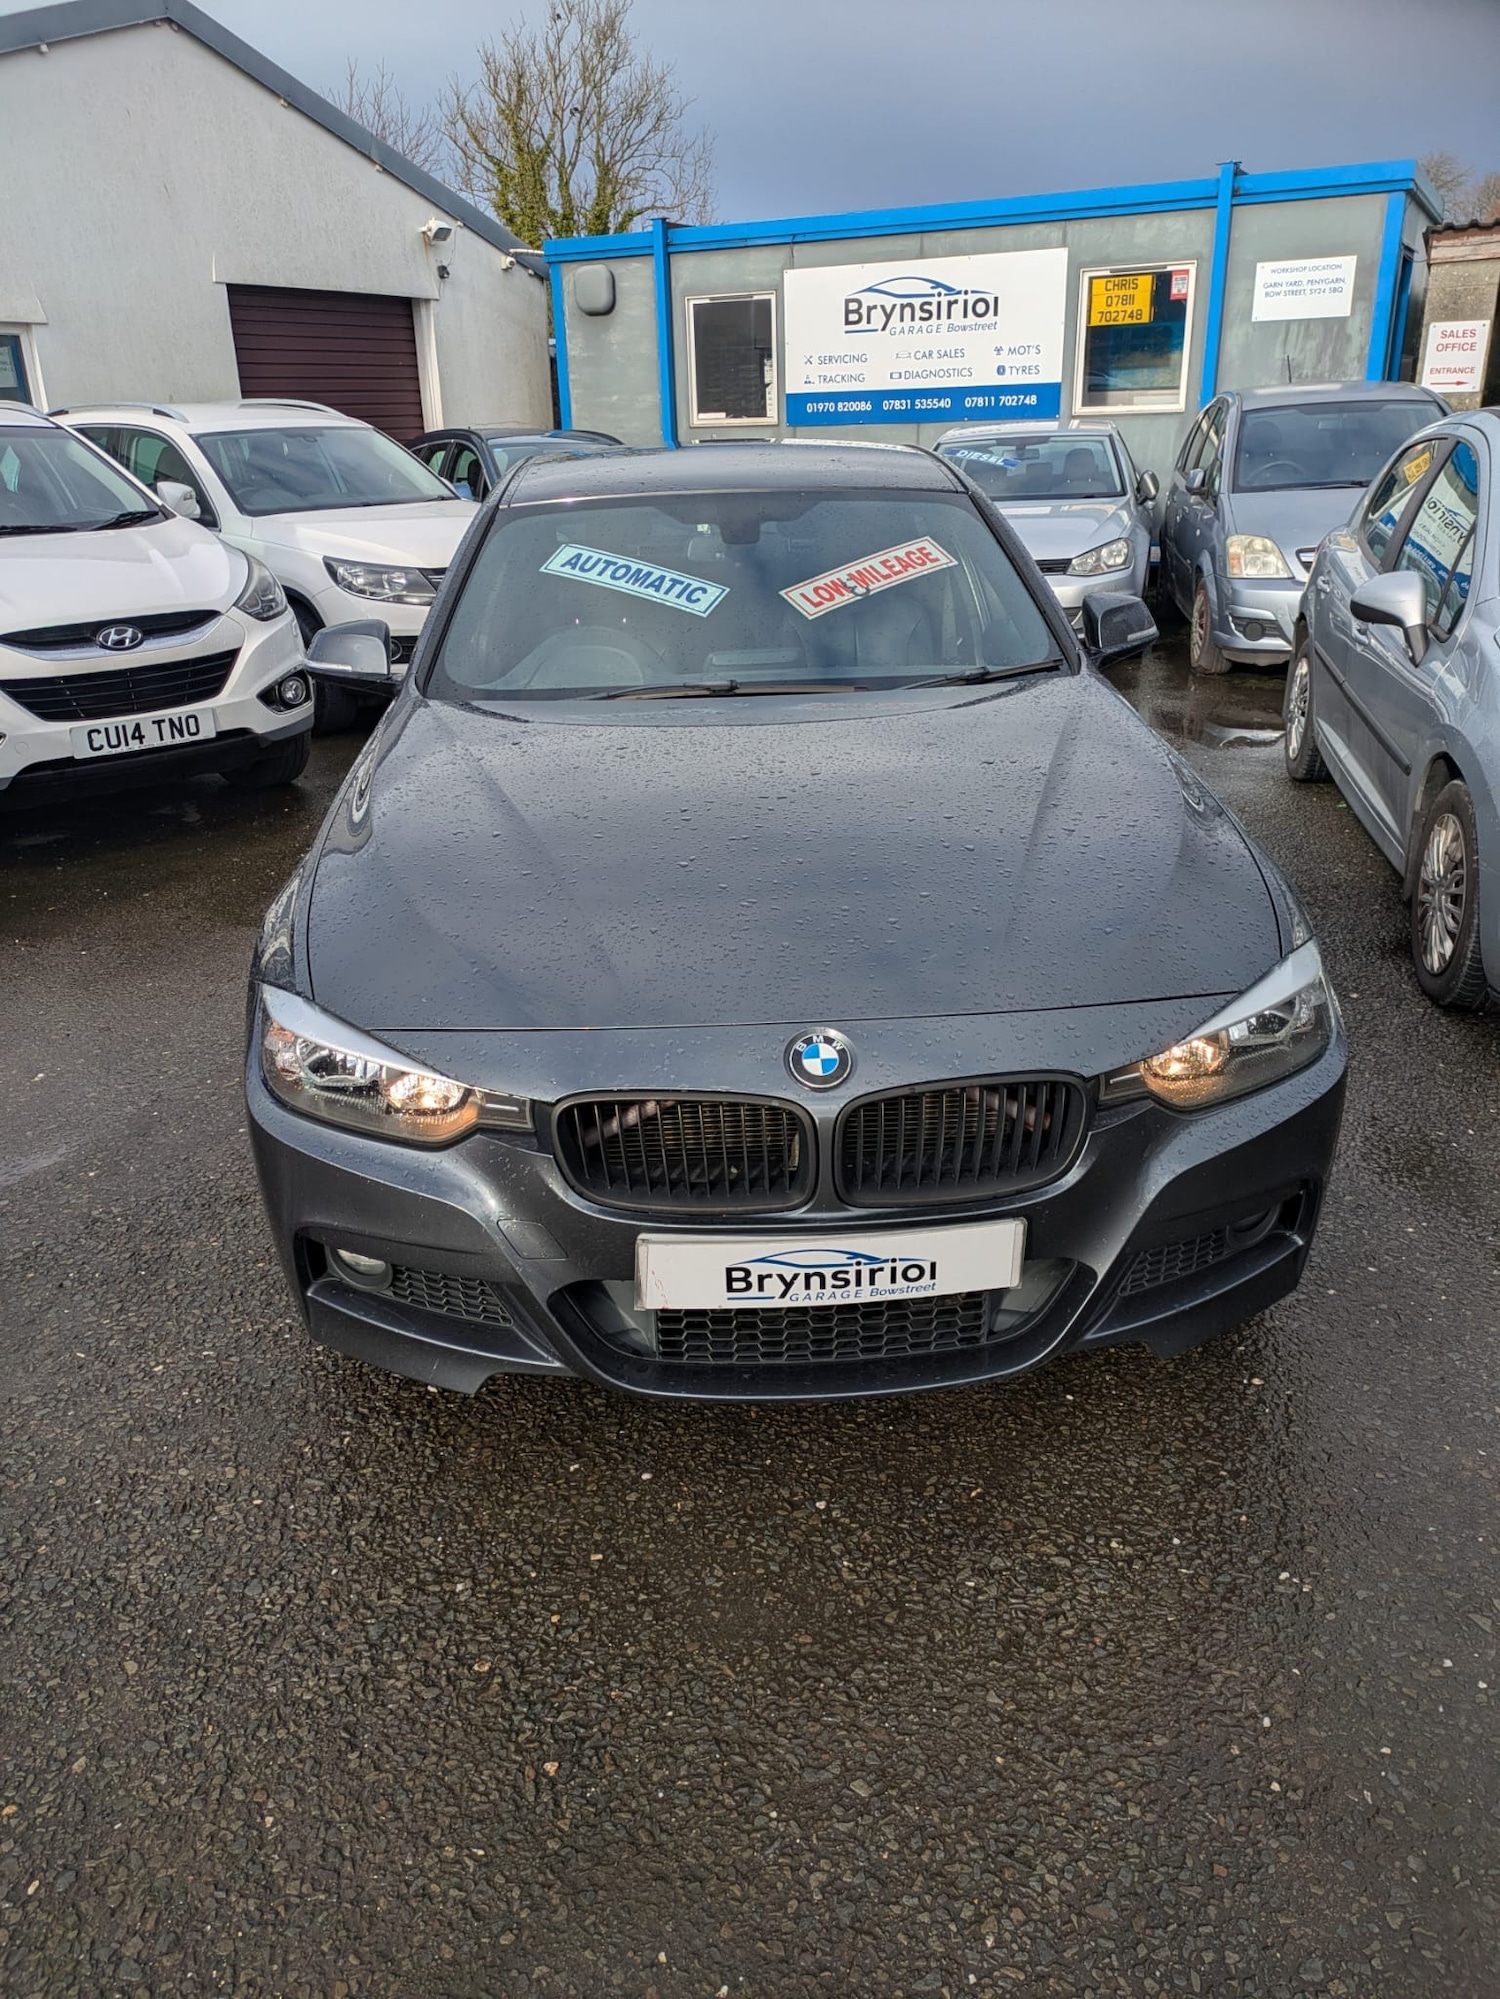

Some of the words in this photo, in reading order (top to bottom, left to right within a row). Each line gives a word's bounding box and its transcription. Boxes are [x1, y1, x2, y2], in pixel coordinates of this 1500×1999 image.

[1270, 266, 1307, 274] WORKSHOP
[1308, 263, 1343, 272] LOCATION
[1104, 278, 1139, 292] CHRIS
[1263, 281, 1283, 289] GARN
[1264, 290, 1281, 298] BOW
[1105, 294, 1135, 308] 07811
[844, 289, 999, 332] Brynsiriol
[1097, 308, 1144, 322] 702748
[889, 324, 943, 336] GARAGE
[946, 321, 998, 333] Bowstreet
[1440, 328, 1477, 339] SALES
[1007, 344, 1041, 356] MOT'S
[1436, 342, 1477, 353] OFFICE
[817, 353, 868, 366] SERVICING
[913, 350, 935, 361] CAR
[937, 348, 966, 359] SALES
[904, 367, 973, 380] DIAGNOSTICS
[1008, 365, 1040, 376] TYRES
[1429, 366, 1476, 375] ENTRANCE
[817, 373, 866, 385] TRACKING
[806, 402, 835, 413] 01970
[837, 401, 872, 412] 820086
[882, 399, 911, 410] 07831
[914, 398, 951, 410] 535540
[965, 397, 995, 408] 07811
[999, 395, 1037, 407] 702748
[956, 449, 1005, 466] DIESEL
[562, 552, 709, 605] AUTOMATIC
[800, 577, 854, 609] LOW
[846, 546, 941, 589] MILEAGE
[87, 722, 146, 752] CU14
[152, 714, 200, 742] TNO
[796, 1034, 845, 1052] BMW
[725, 1257, 937, 1299] Brynsiriol
[789, 1288, 864, 1302] GARAGE
[869, 1282, 937, 1297] Bowstreet
